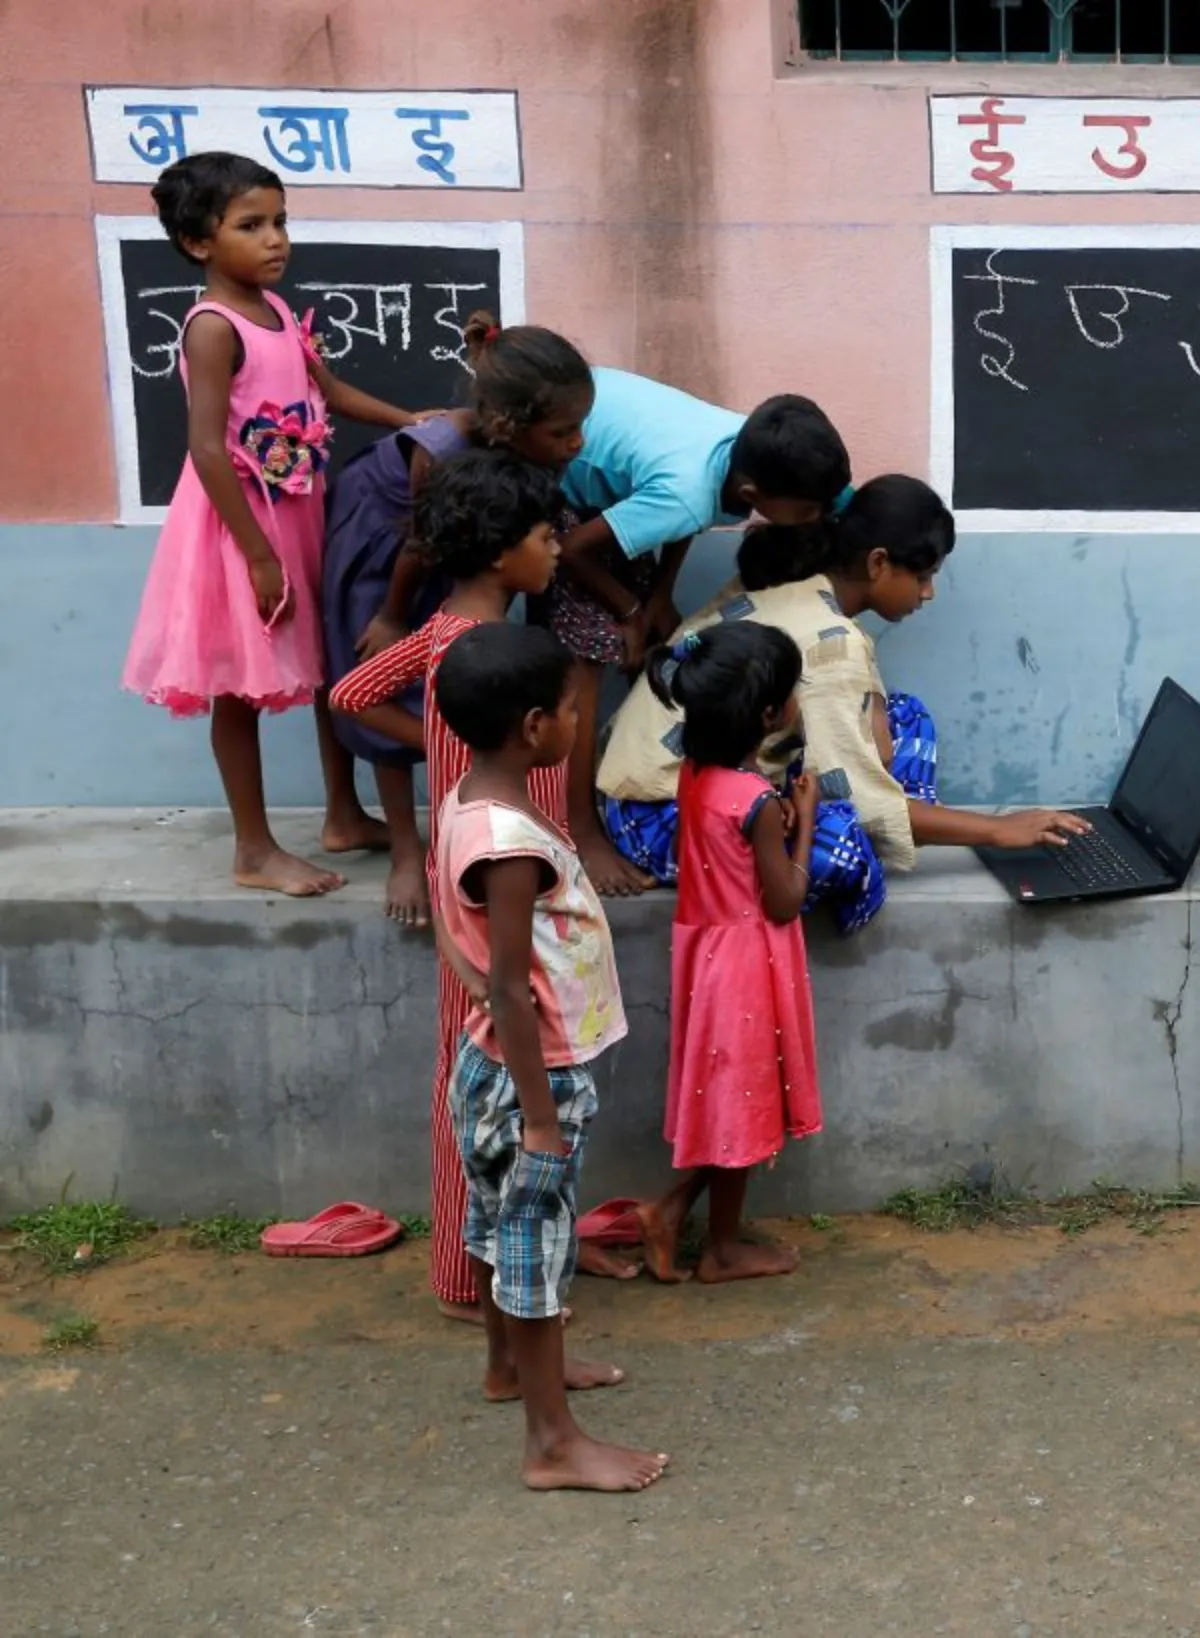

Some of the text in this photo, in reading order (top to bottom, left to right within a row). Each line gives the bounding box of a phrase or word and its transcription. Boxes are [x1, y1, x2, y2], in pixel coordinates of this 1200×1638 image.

[123, 103, 470, 184] अ आ इ
[957, 98, 1027, 190] ई
[1082, 114, 1152, 180] उ
[424, 282, 488, 380] इ
[962, 248, 1039, 391] ई
